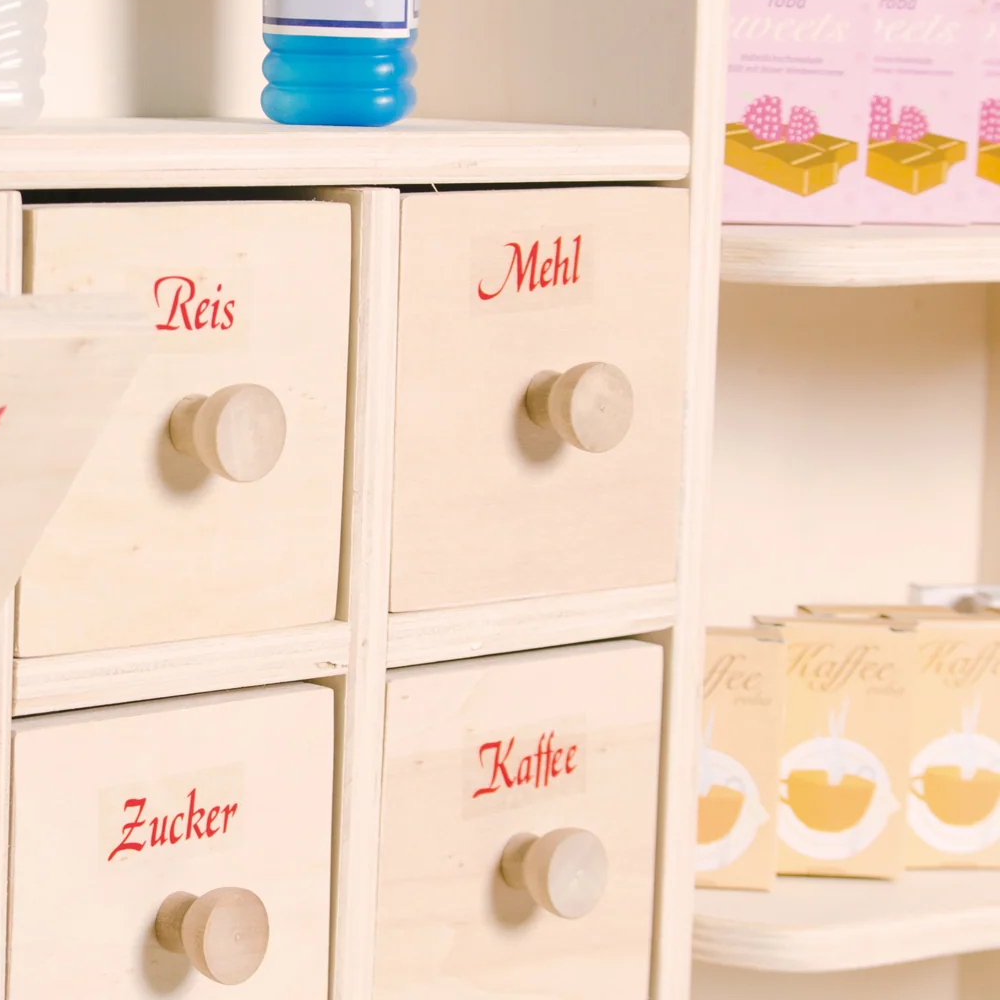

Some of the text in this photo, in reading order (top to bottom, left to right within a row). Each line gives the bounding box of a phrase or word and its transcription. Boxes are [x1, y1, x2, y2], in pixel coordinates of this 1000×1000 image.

[478, 235, 581, 300] Mehl
[154, 276, 235, 331] Reis
[786, 641, 896, 692] Kaffee
[472, 732, 578, 798] Kaffee
[108, 788, 239, 861] Zucker
